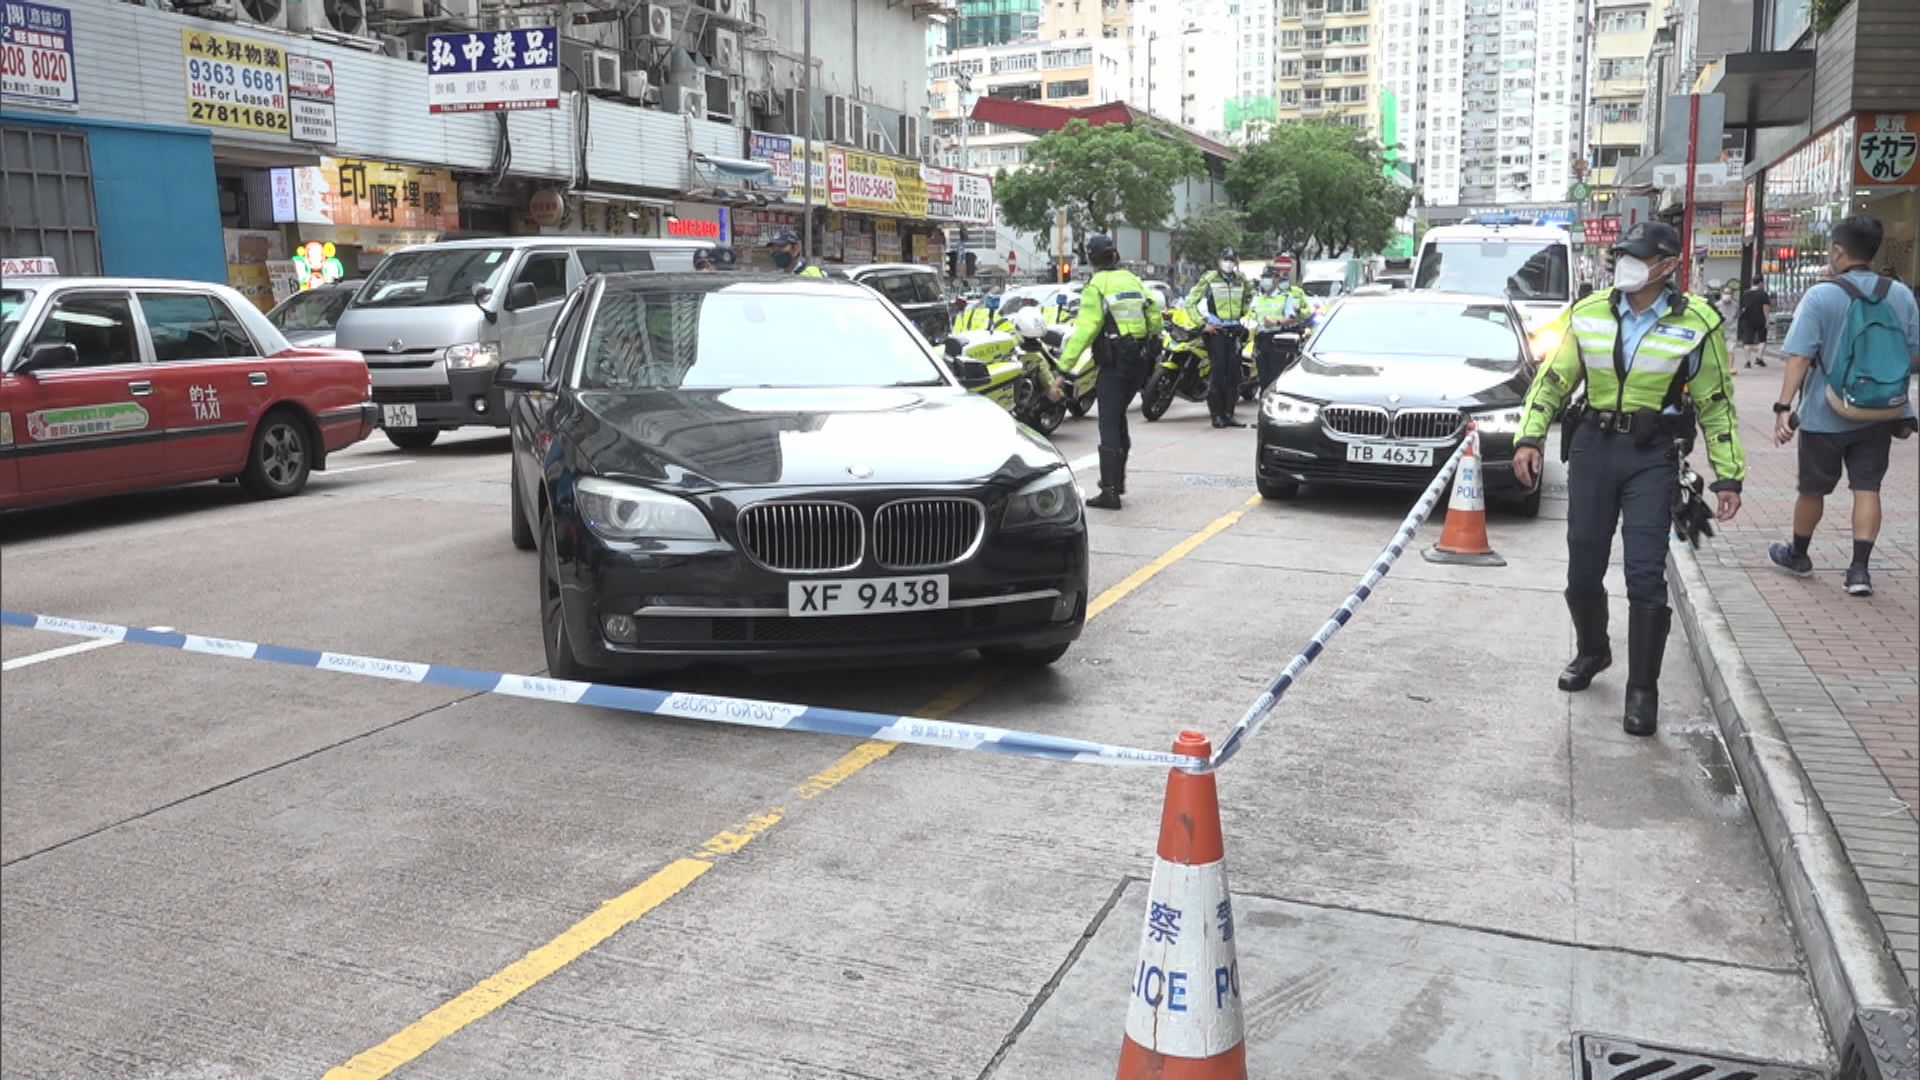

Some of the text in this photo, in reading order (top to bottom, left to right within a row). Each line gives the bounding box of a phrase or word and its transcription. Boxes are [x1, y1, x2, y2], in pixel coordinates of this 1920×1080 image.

[432, 30, 548, 71] 弘中獎品
[32, 50, 67, 83] 8020
[189, 59, 235, 85] 9363
[242, 68, 283, 93] 6681
[192, 82, 207, 97] 出
[210, 86, 230, 100] For
[235, 89, 270, 107] Lease
[191, 102, 288, 129] 27811682
[1861, 136, 1915, 159] チカラ
[1873, 160, 1904, 178] めし
[849, 176, 893, 199] 8105-5645
[953, 194, 971, 216] 8300
[189, 385, 218, 401] 的士
[192, 402, 221, 419] TAXI
[1352, 446, 1429, 463] TB 4637
[800, 580, 939, 611] XF 9438
[1149, 901, 1182, 945] 察
